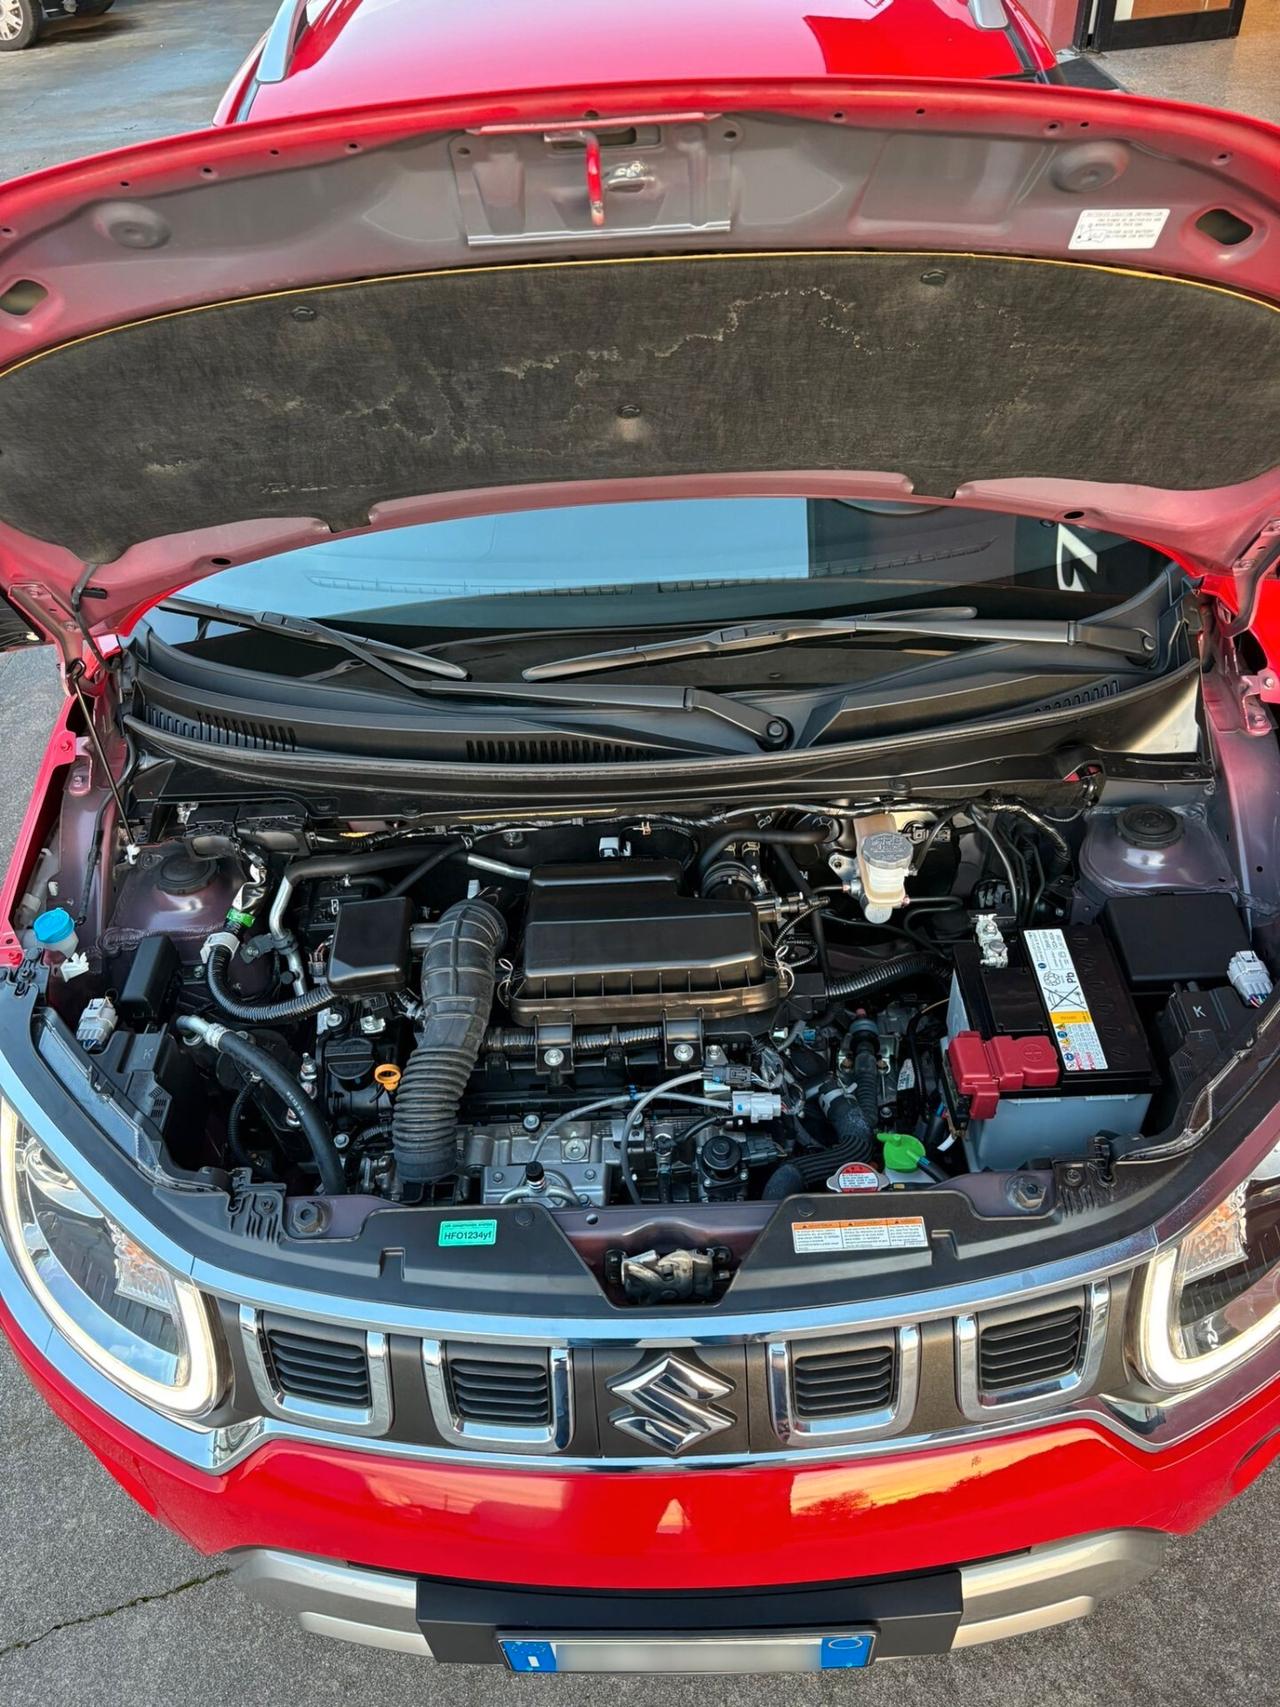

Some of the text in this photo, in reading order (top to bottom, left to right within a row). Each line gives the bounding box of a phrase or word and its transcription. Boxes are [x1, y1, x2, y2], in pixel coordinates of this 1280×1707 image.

[1066, 972, 1077, 984] Pb
[1192, 1006, 1207, 1018] K
[444, 1231, 492, 1241] HFO1234yf
